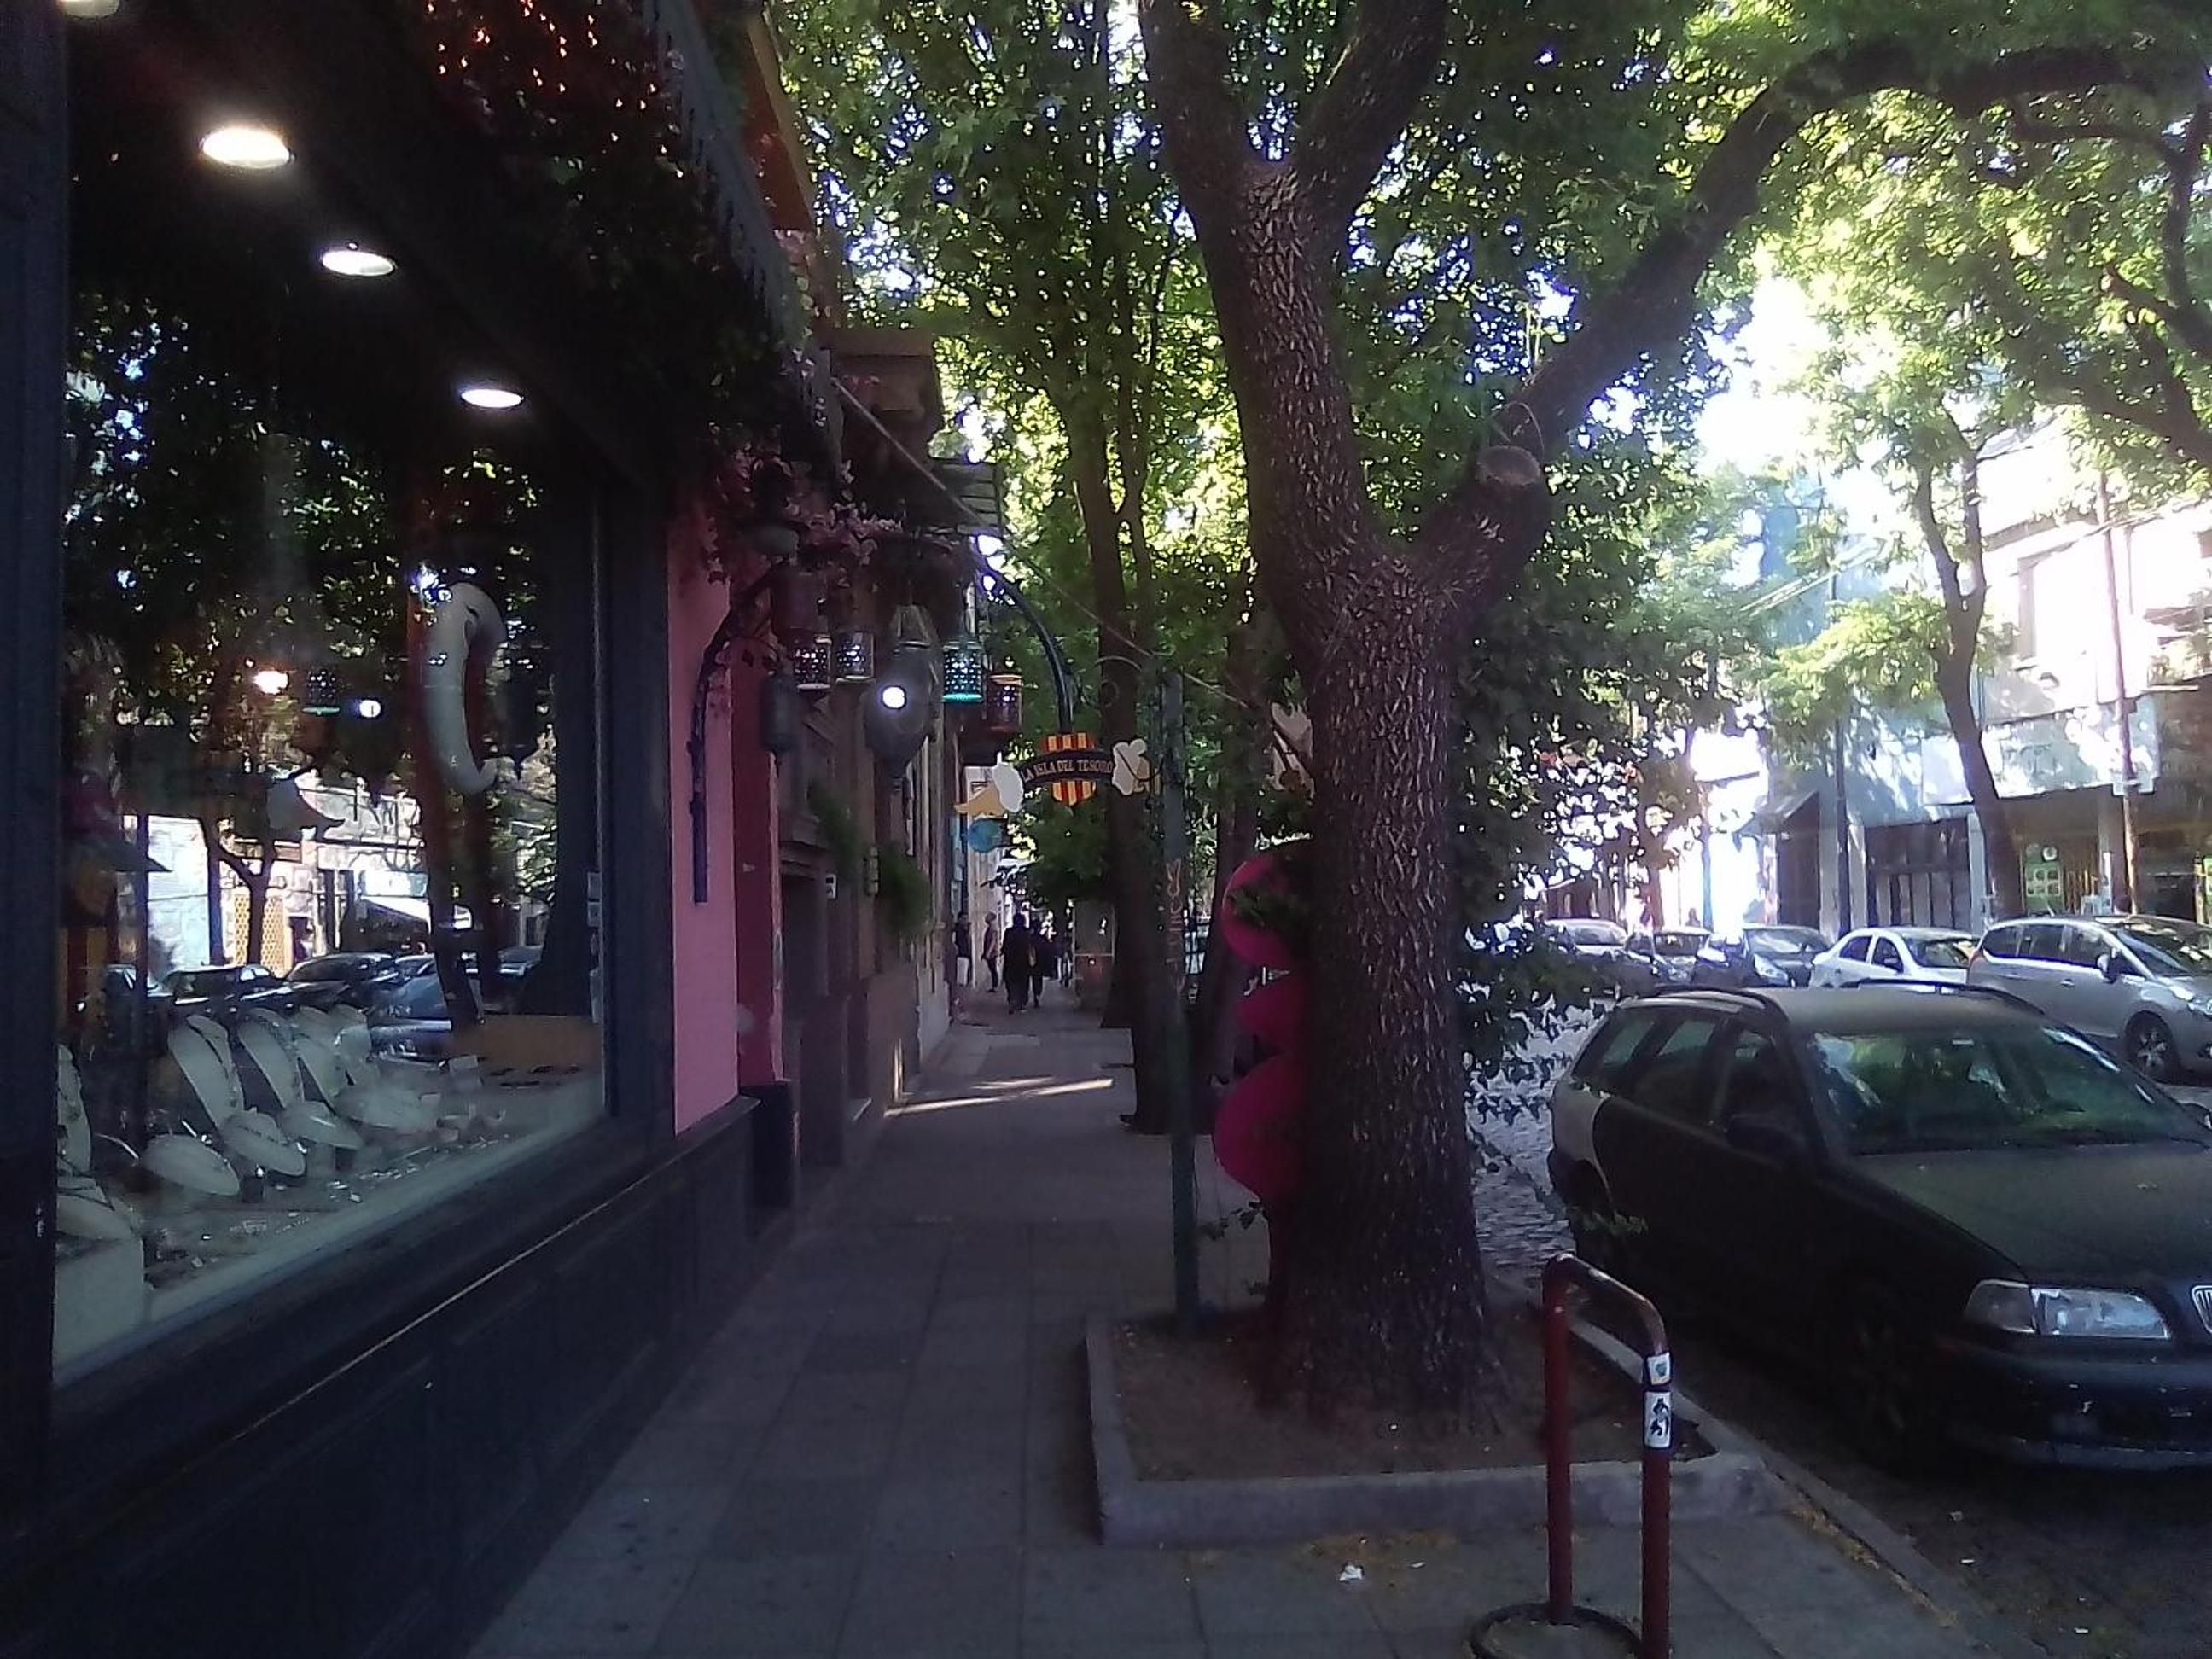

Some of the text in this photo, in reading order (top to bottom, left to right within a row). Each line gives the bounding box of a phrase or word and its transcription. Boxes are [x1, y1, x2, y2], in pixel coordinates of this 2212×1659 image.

[1021, 760, 1114, 783] LA ISLA DEL TESORO
